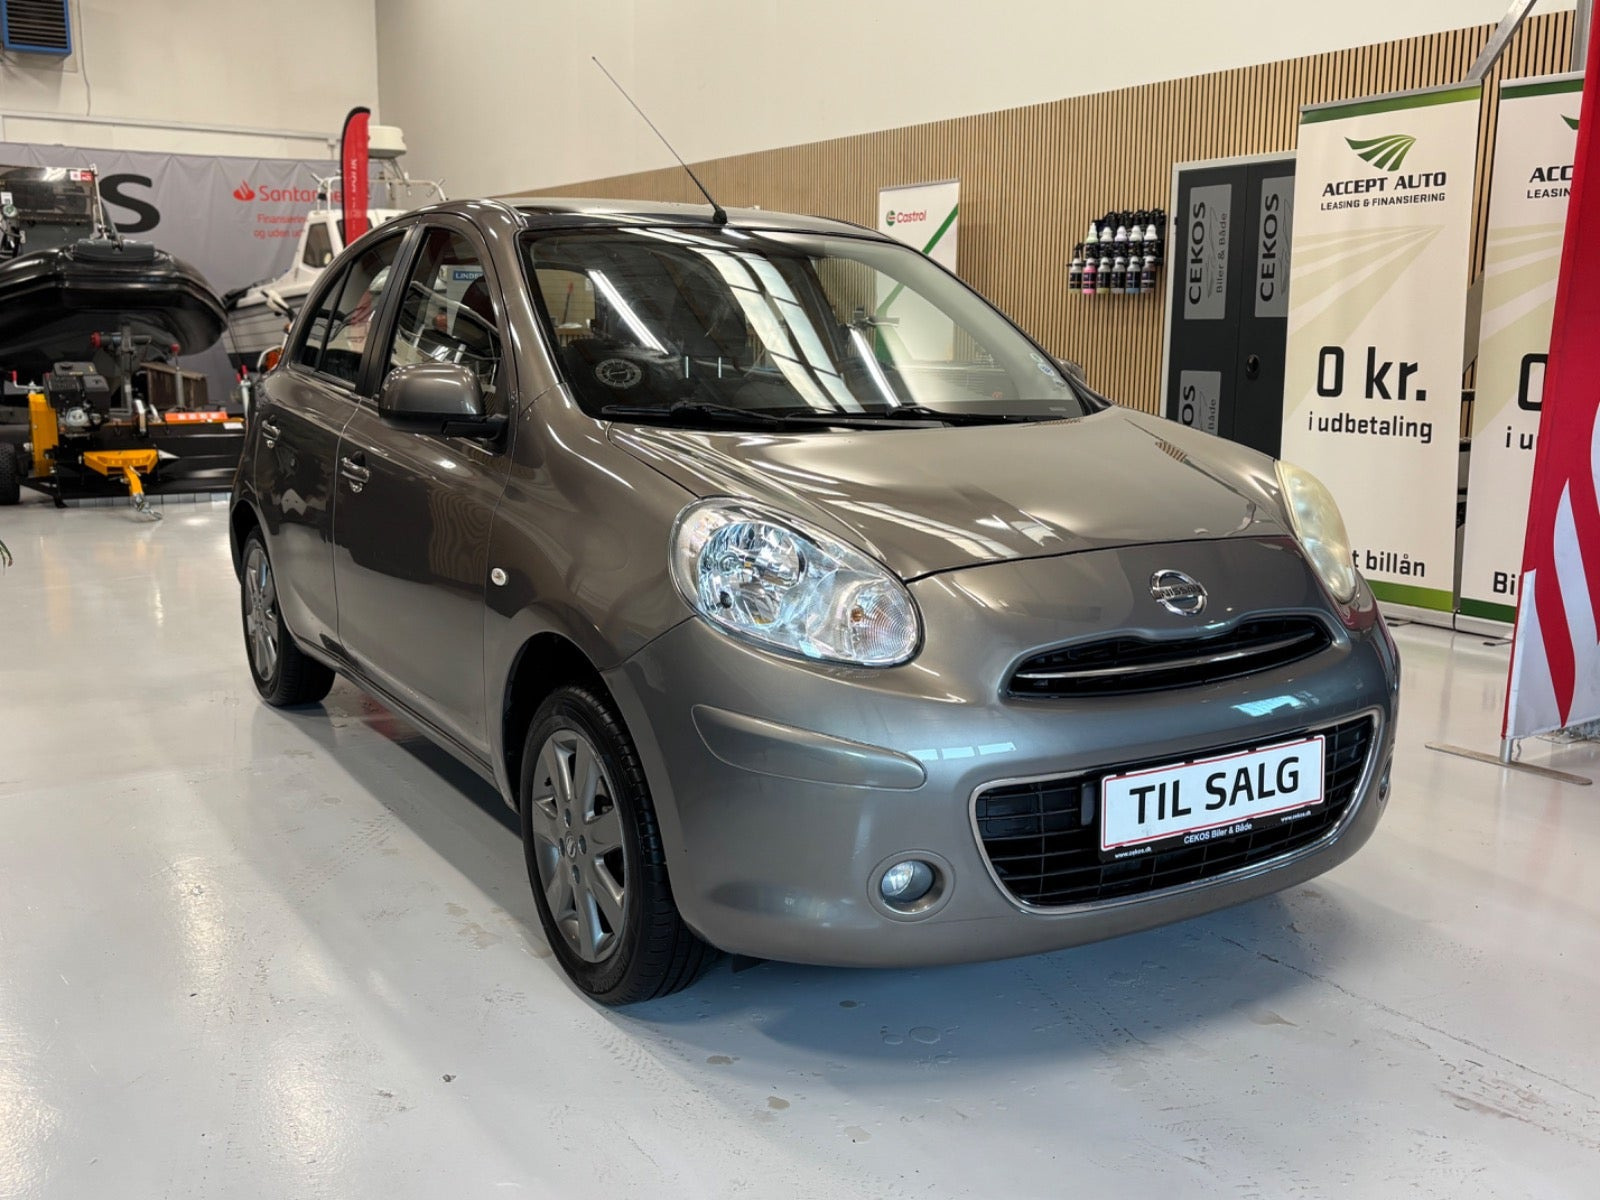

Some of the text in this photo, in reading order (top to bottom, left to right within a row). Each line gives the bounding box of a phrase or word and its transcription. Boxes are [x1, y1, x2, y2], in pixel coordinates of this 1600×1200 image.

[1322, 171, 1447, 197] ACCEPT AUTO
[1321, 192, 1446, 211] LEASING & FINANSIERING
[896, 210, 927, 223] Castrol
[1188, 201, 1206, 305] CEKOS
[1216, 213, 1228, 293] Biler & Både
[1260, 193, 1279, 302] CEKOS
[1365, 346, 1427, 402] kr.
[1308, 411, 1433, 444] i udbetaling
[1506, 425, 1513, 448] i
[1366, 550, 1425, 577] billån
[1161, 583, 1203, 600] NISSAN
[1129, 755, 1300, 826] TIL SALG
[1183, 822, 1253, 845] CEKOS Biler & Både
